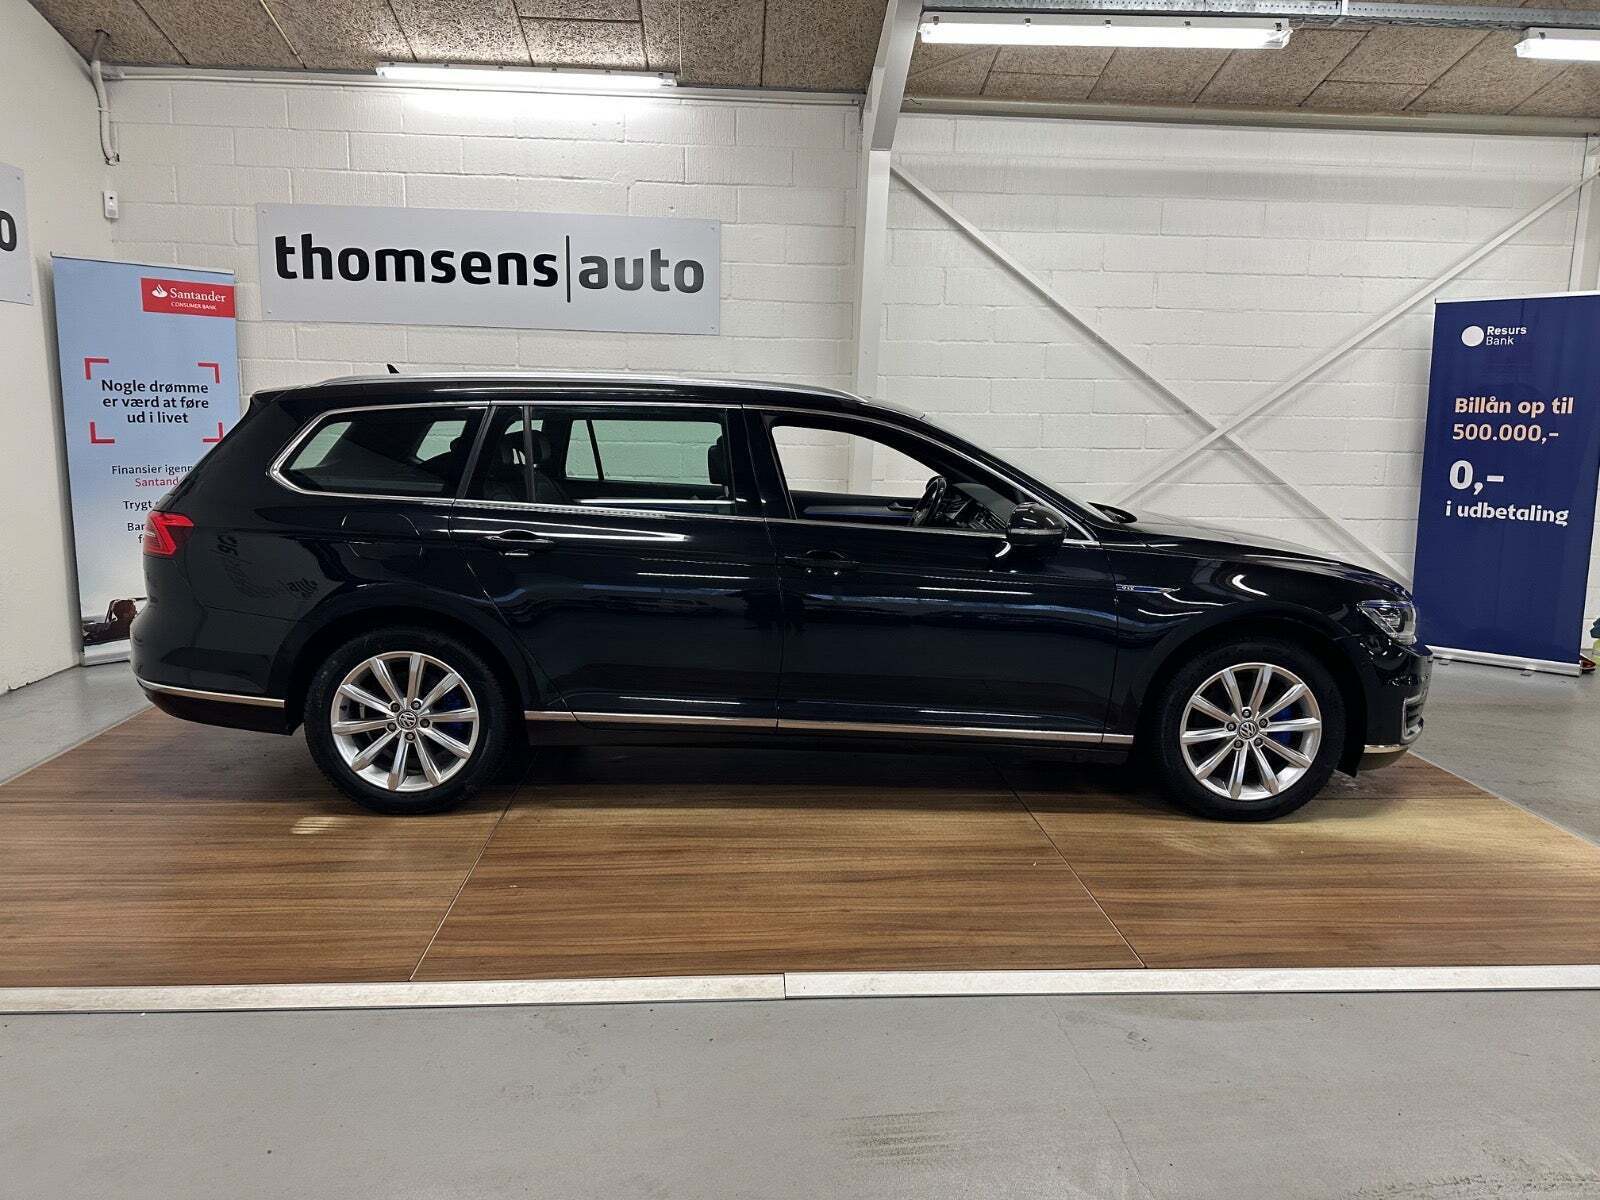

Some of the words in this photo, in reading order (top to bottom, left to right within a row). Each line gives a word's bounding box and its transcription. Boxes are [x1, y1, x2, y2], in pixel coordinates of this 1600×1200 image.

[274, 233, 559, 288] thomsens
[578, 247, 705, 294] auto
[169, 287, 226, 302] Santander
[170, 301, 201, 309] CONSUMER
[1487, 325, 1527, 336] Resurs
[1486, 336, 1514, 346] Bank
[101, 379, 146, 396] Nogle
[149, 380, 209, 394] drømme
[102, 397, 118, 407] er
[121, 396, 160, 408] værd
[163, 397, 177, 408] at
[180, 396, 209, 409] føre
[1454, 395, 1511, 415] Billån
[1517, 399, 1545, 418] op
[1551, 396, 1574, 415] til
[127, 411, 145, 423] ud
[149, 411, 153, 423] i
[157, 411, 189, 424] livet
[1452, 423, 1559, 444] 500.000,-
[111, 464, 161, 475] Finansier
[135, 477, 179, 487] Santand
[1449, 459, 1505, 495] 0,-
[123, 500, 152, 511] Trygt
[1445, 500, 1452, 517] i
[1457, 501, 1570, 527] udbetaling
